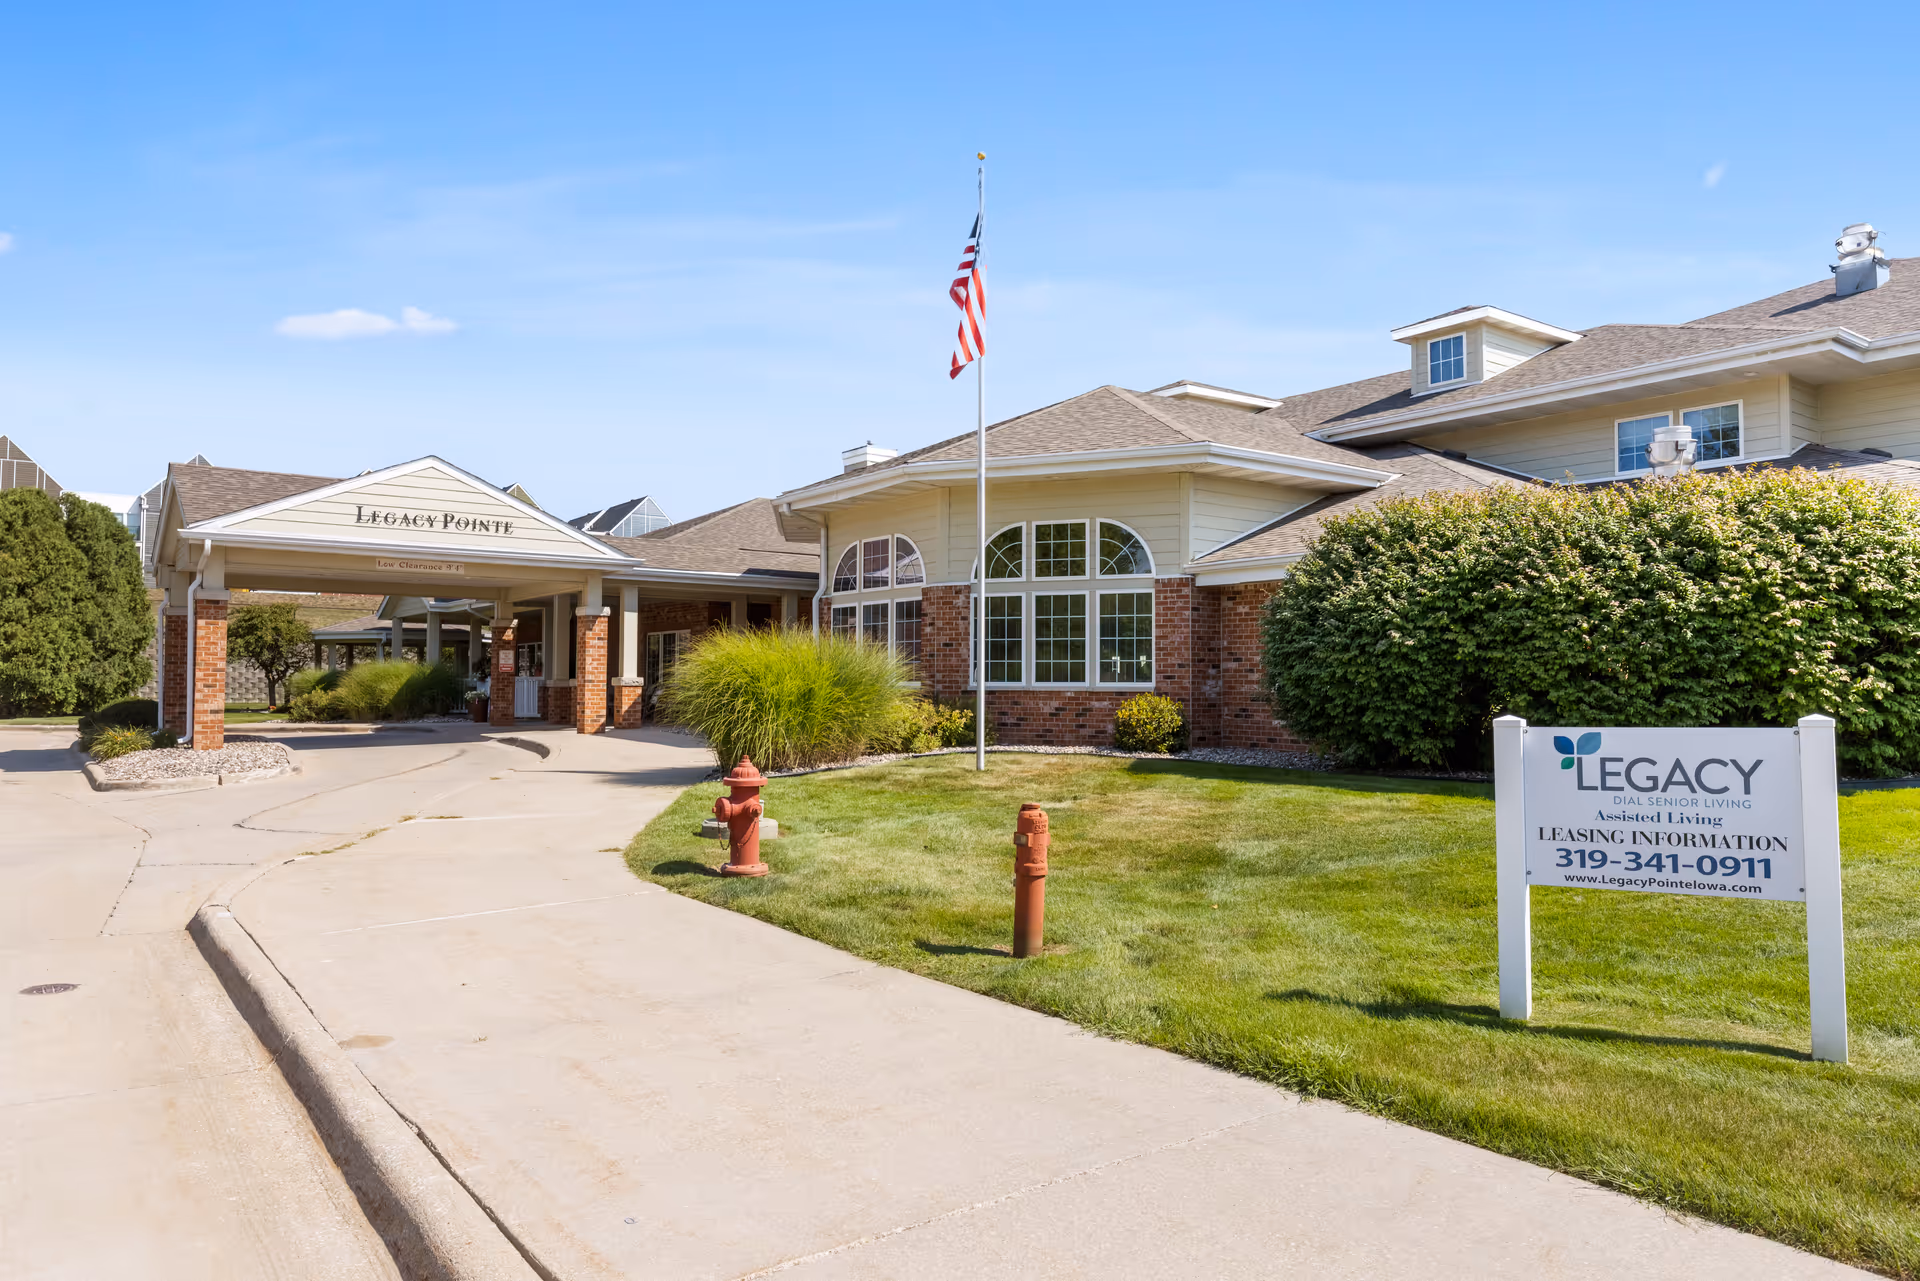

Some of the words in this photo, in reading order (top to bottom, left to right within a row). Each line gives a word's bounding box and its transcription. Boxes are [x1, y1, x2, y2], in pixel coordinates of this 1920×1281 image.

[355, 505, 438, 529] LEGACY
[442, 512, 514, 536] POINTE
[378, 560, 396, 568] Low
[399, 561, 443, 571] Clearance
[1577, 756, 1764, 795] LEGACY
[1613, 795, 1643, 806] DIAL
[1648, 796, 1699, 808] SENIOR
[1704, 797, 1752, 809] LIVING
[1594, 809, 1661, 824] Assisted
[1667, 811, 1723, 828] Living
[1537, 826, 1625, 845] LEASING
[1632, 830, 1789, 852] INFORMATION
[1555, 848, 1772, 879] 319-341-0911
